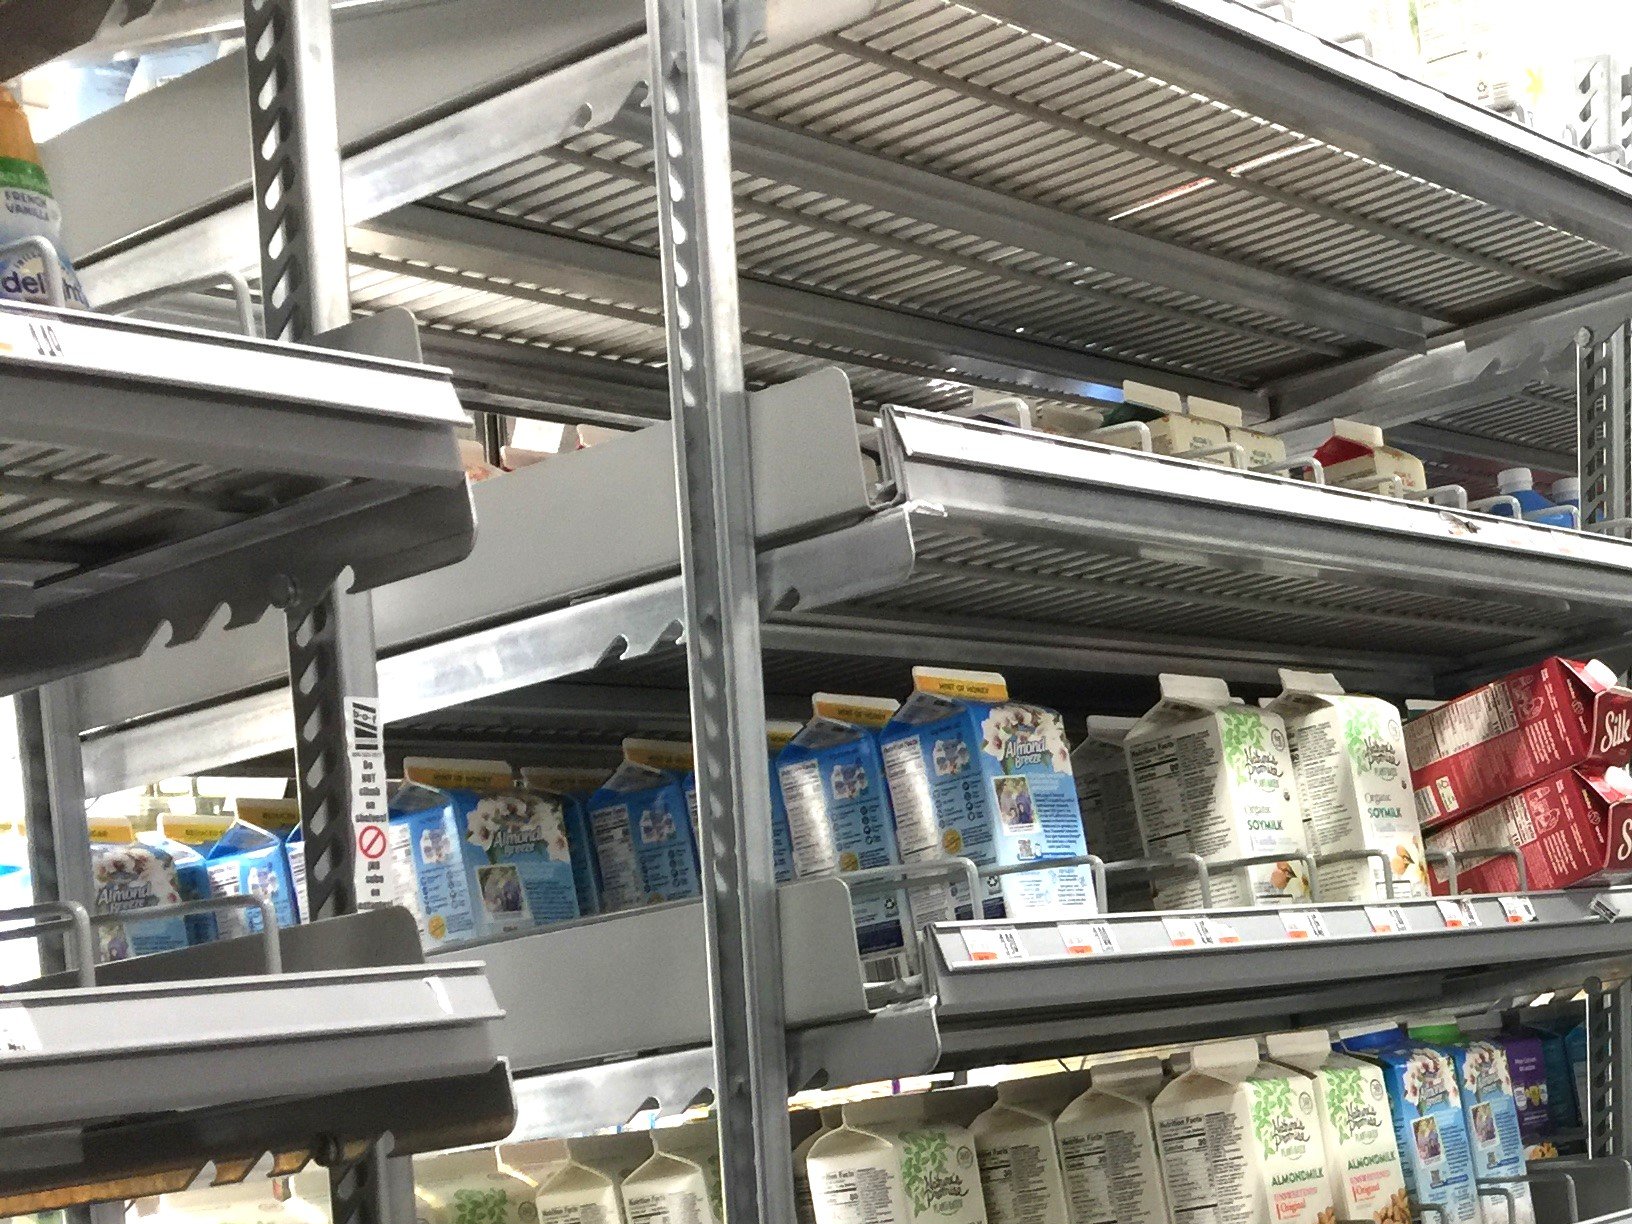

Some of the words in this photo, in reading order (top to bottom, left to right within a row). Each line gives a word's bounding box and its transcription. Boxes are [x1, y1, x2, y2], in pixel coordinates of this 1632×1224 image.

[1600, 709, 1631, 753] Silk
[1005, 735, 1047, 758] Almond
[1014, 752, 1042, 770] Breeze
[1247, 818, 1283, 831] SOYMILK
[1348, 1151, 1397, 1170] ALMONDMILK
[1272, 1167, 1324, 1187] ALMONDMILK
